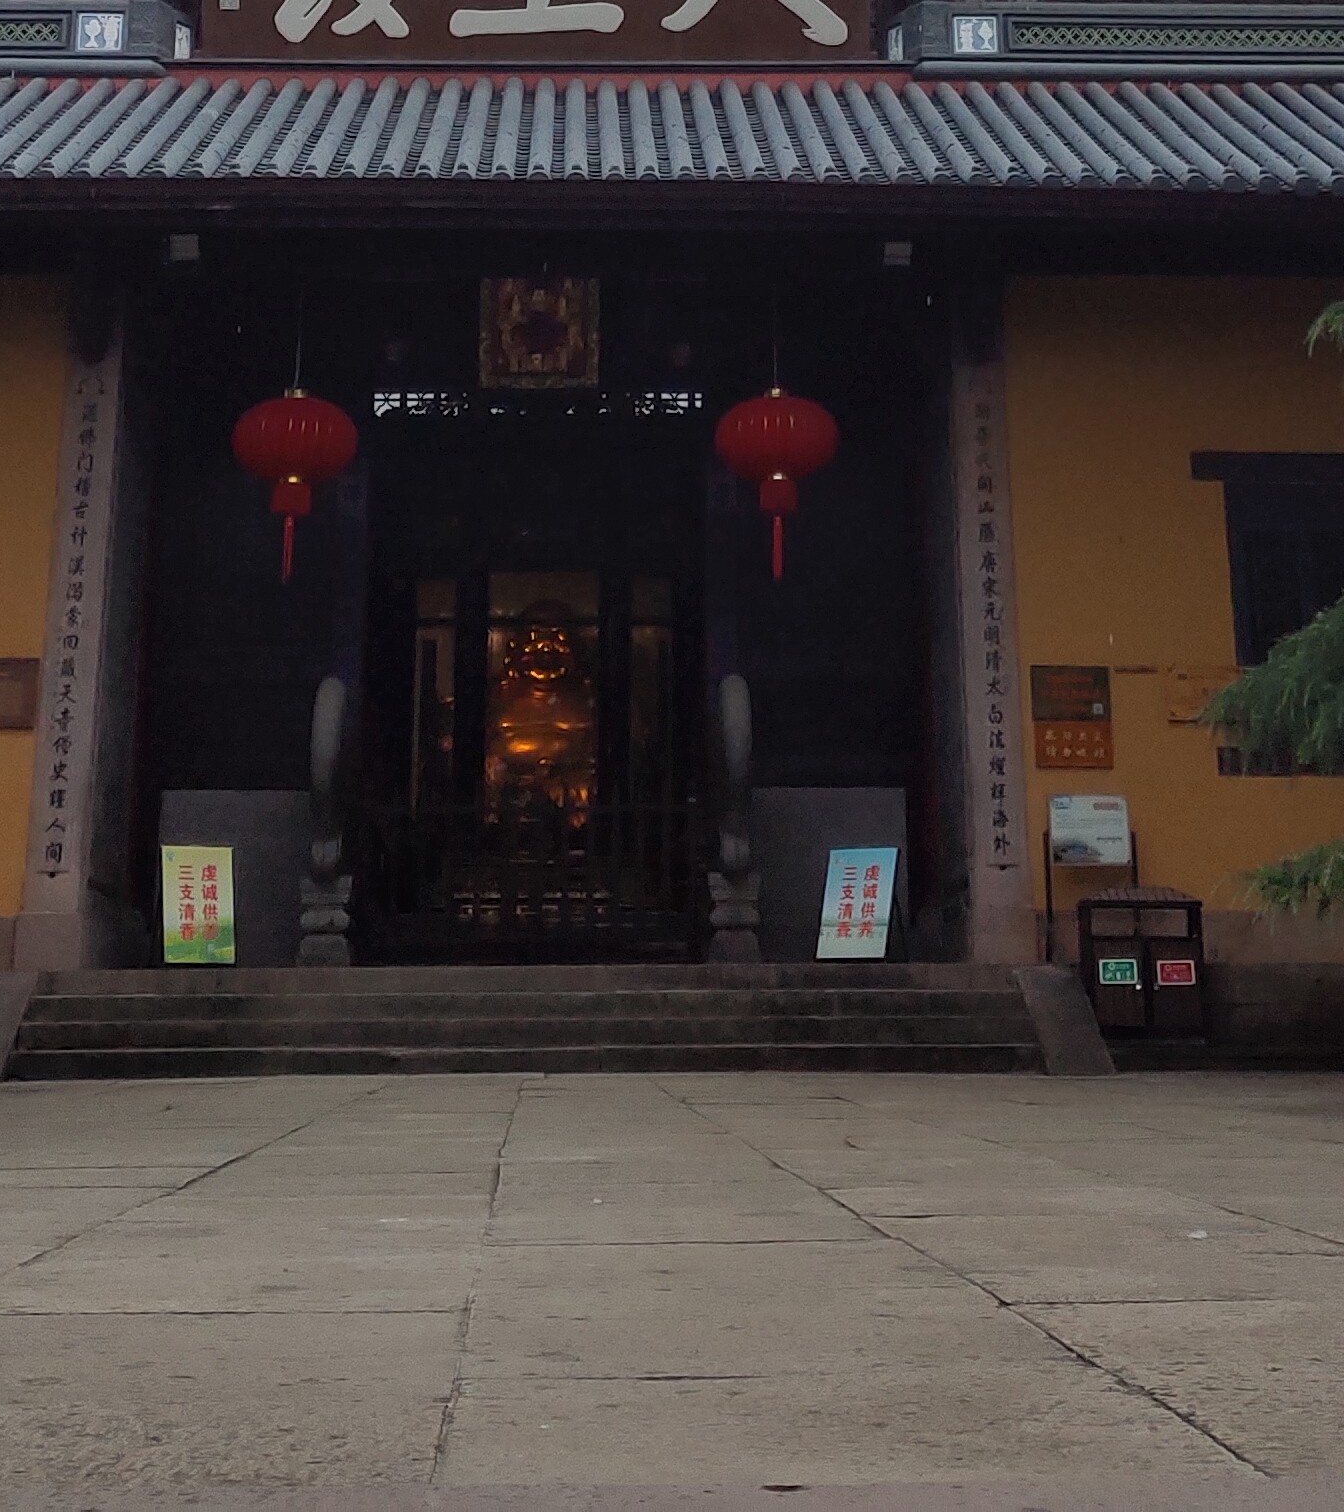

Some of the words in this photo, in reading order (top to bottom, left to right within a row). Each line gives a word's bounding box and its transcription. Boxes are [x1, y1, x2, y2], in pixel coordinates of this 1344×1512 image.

[178, 865, 196, 940] 三支清香
[837, 866, 857, 937] 三支清香
[858, 865, 880, 937] 虔诚供养
